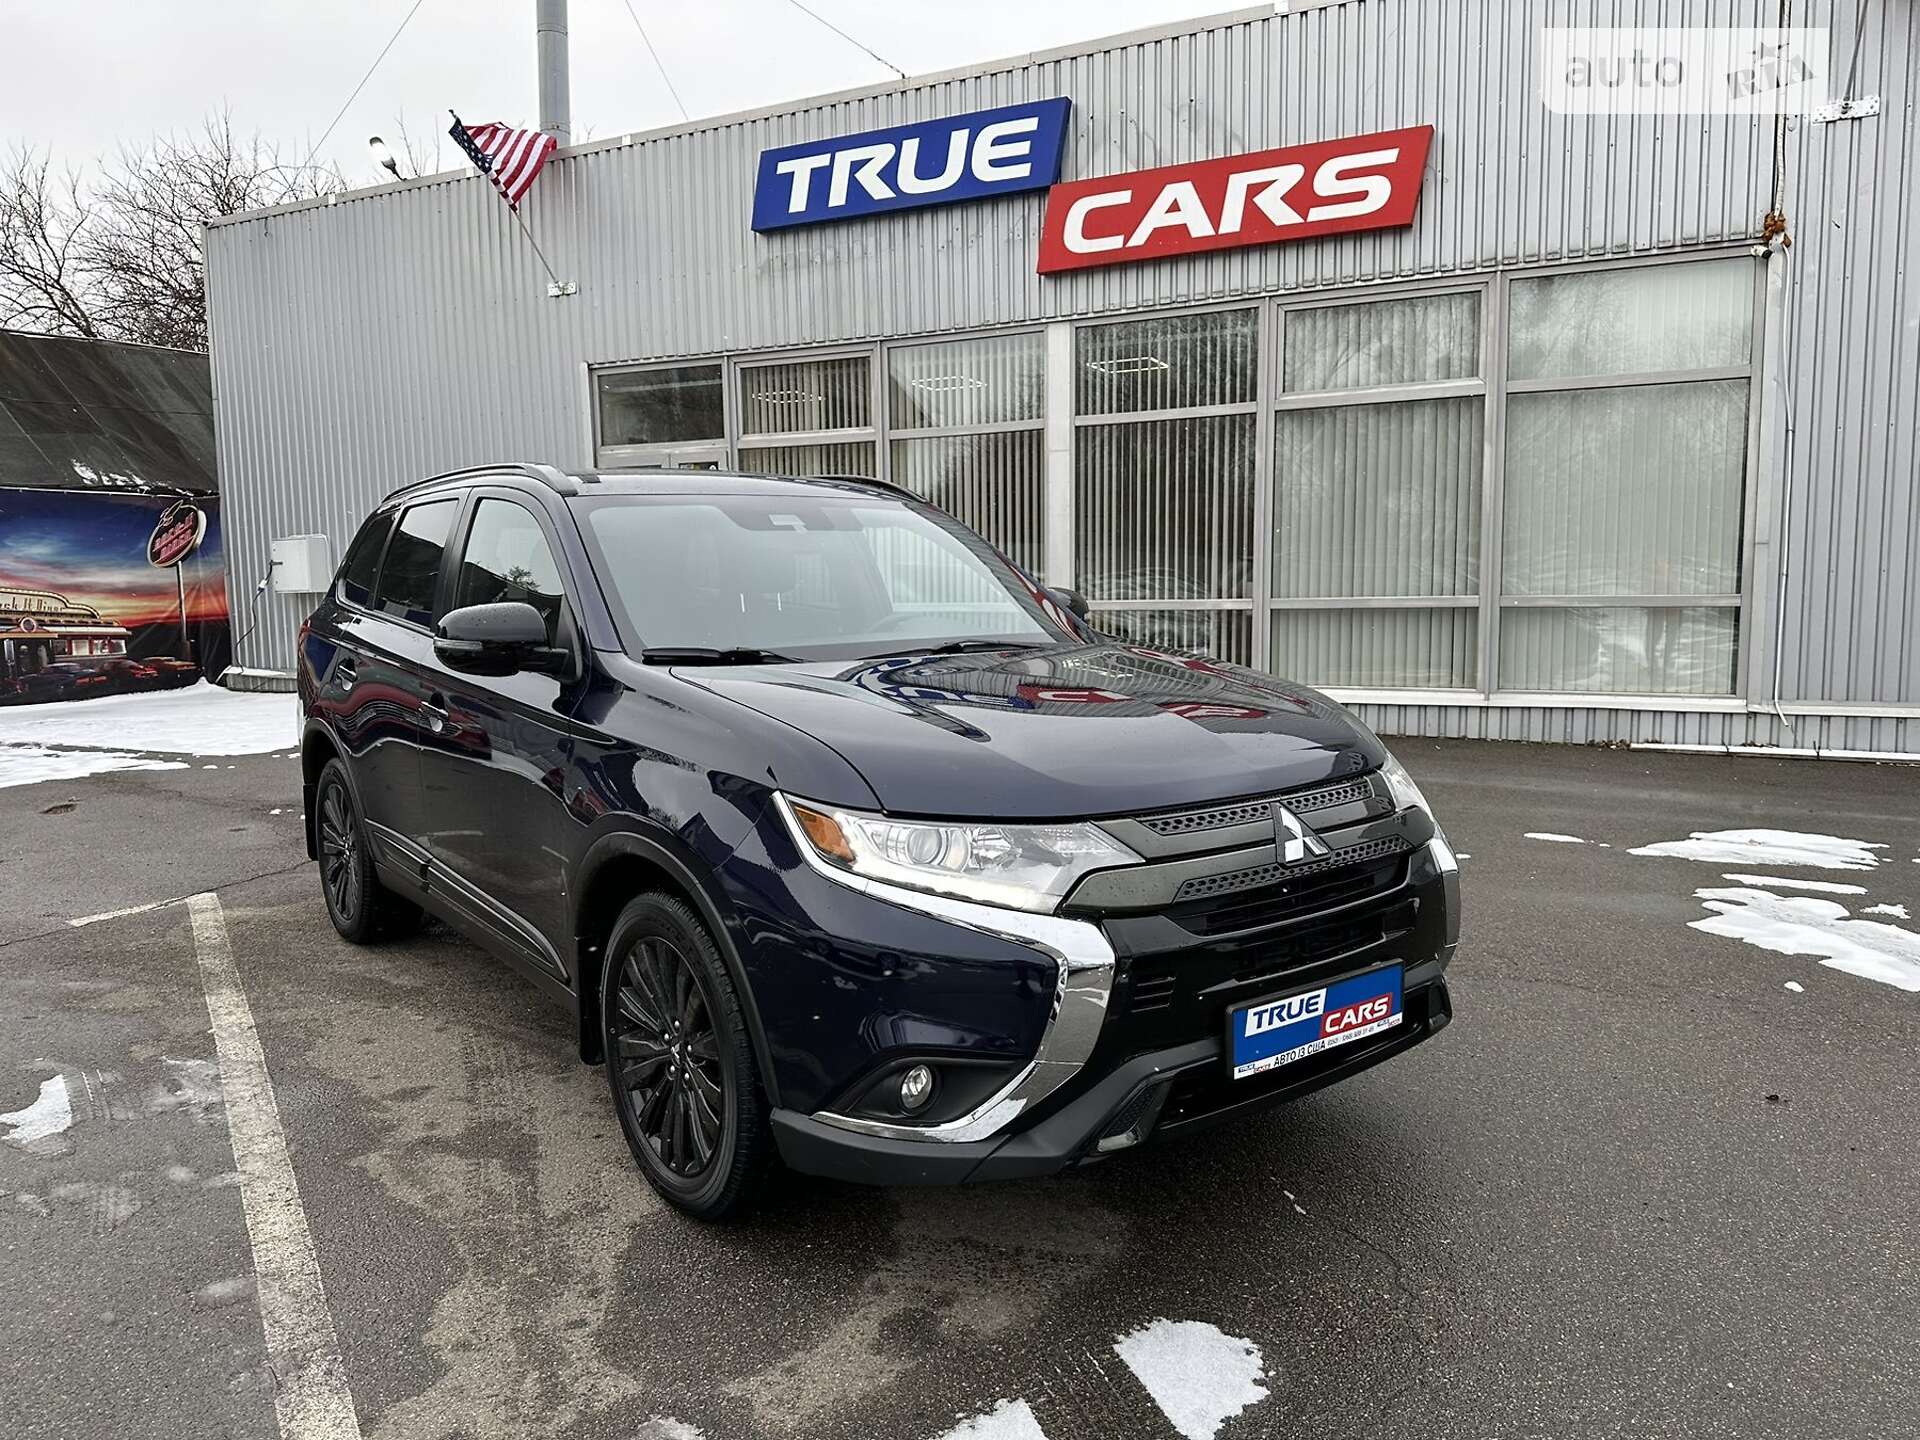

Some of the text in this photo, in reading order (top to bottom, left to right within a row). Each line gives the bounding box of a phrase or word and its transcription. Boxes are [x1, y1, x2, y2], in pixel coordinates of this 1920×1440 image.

[776, 117, 1399, 254] TRUE CARS
[1253, 994, 1389, 1033] TRUE CARS
[1273, 1049, 1296, 1067] АВТО
[1307, 1039, 1326, 1055] США
